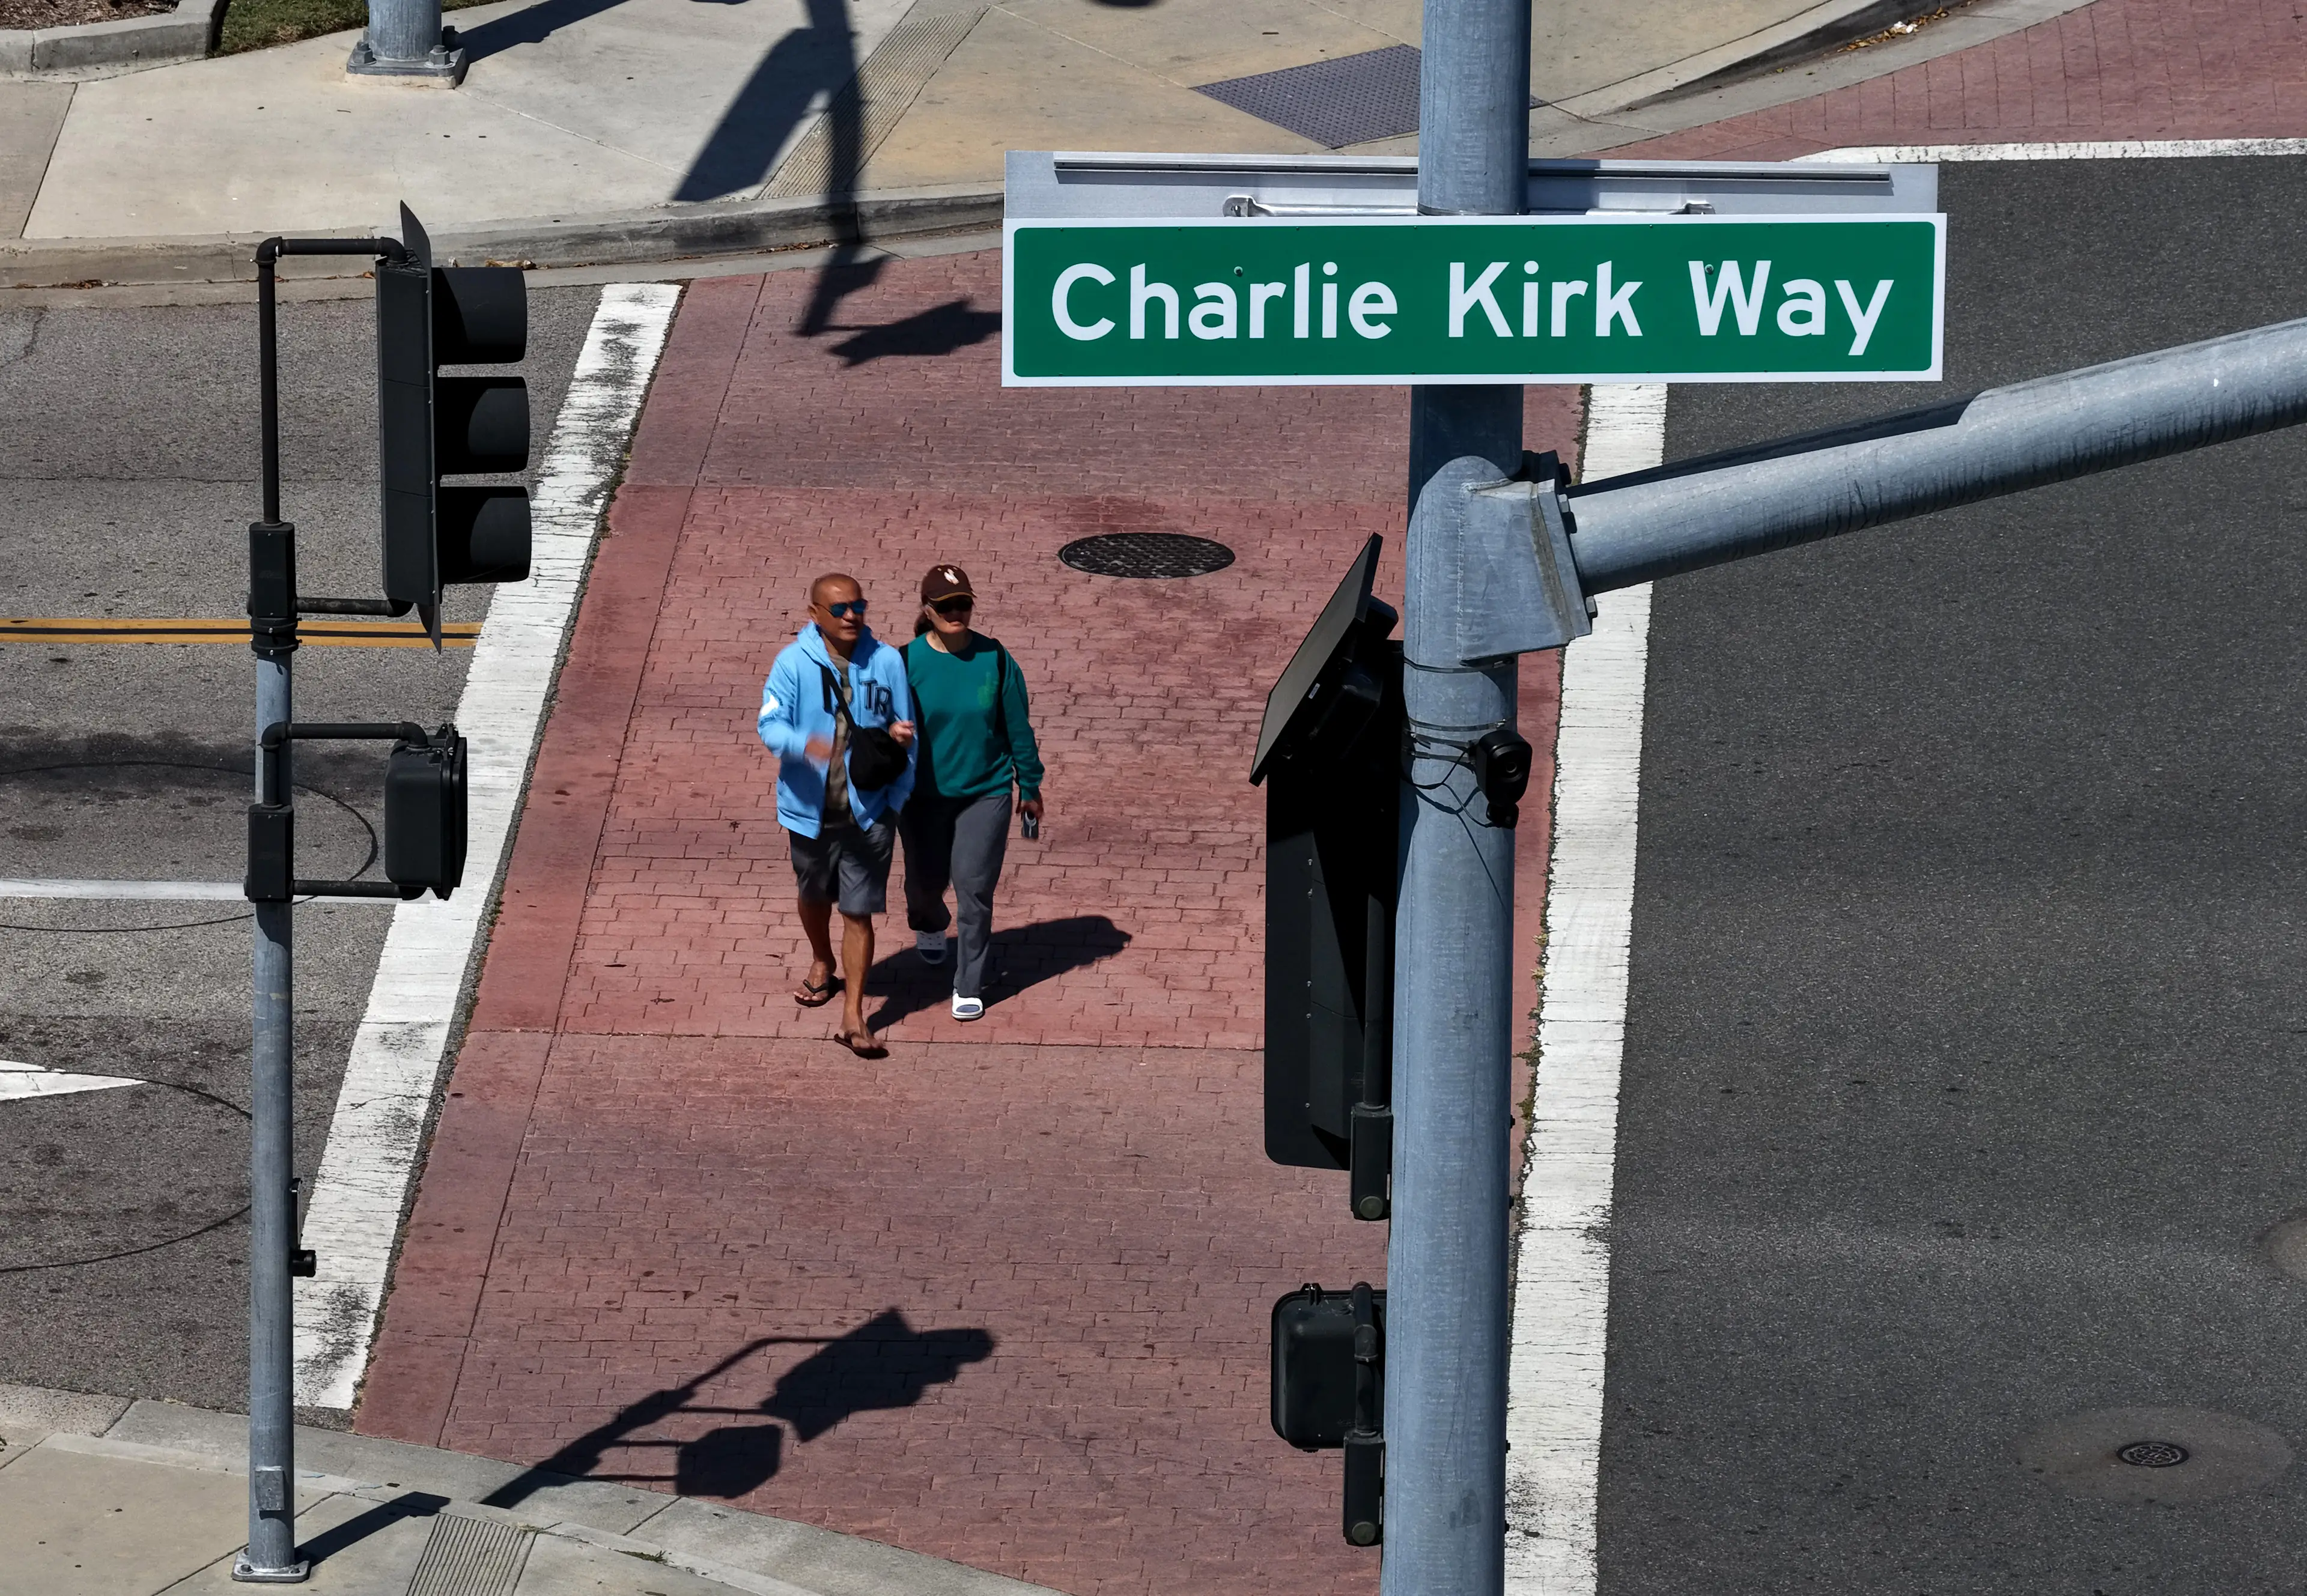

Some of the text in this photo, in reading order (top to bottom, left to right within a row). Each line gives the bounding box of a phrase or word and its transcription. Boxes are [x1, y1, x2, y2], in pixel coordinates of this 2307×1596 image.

[1052, 259, 1895, 356] Charlie Kirk Way
